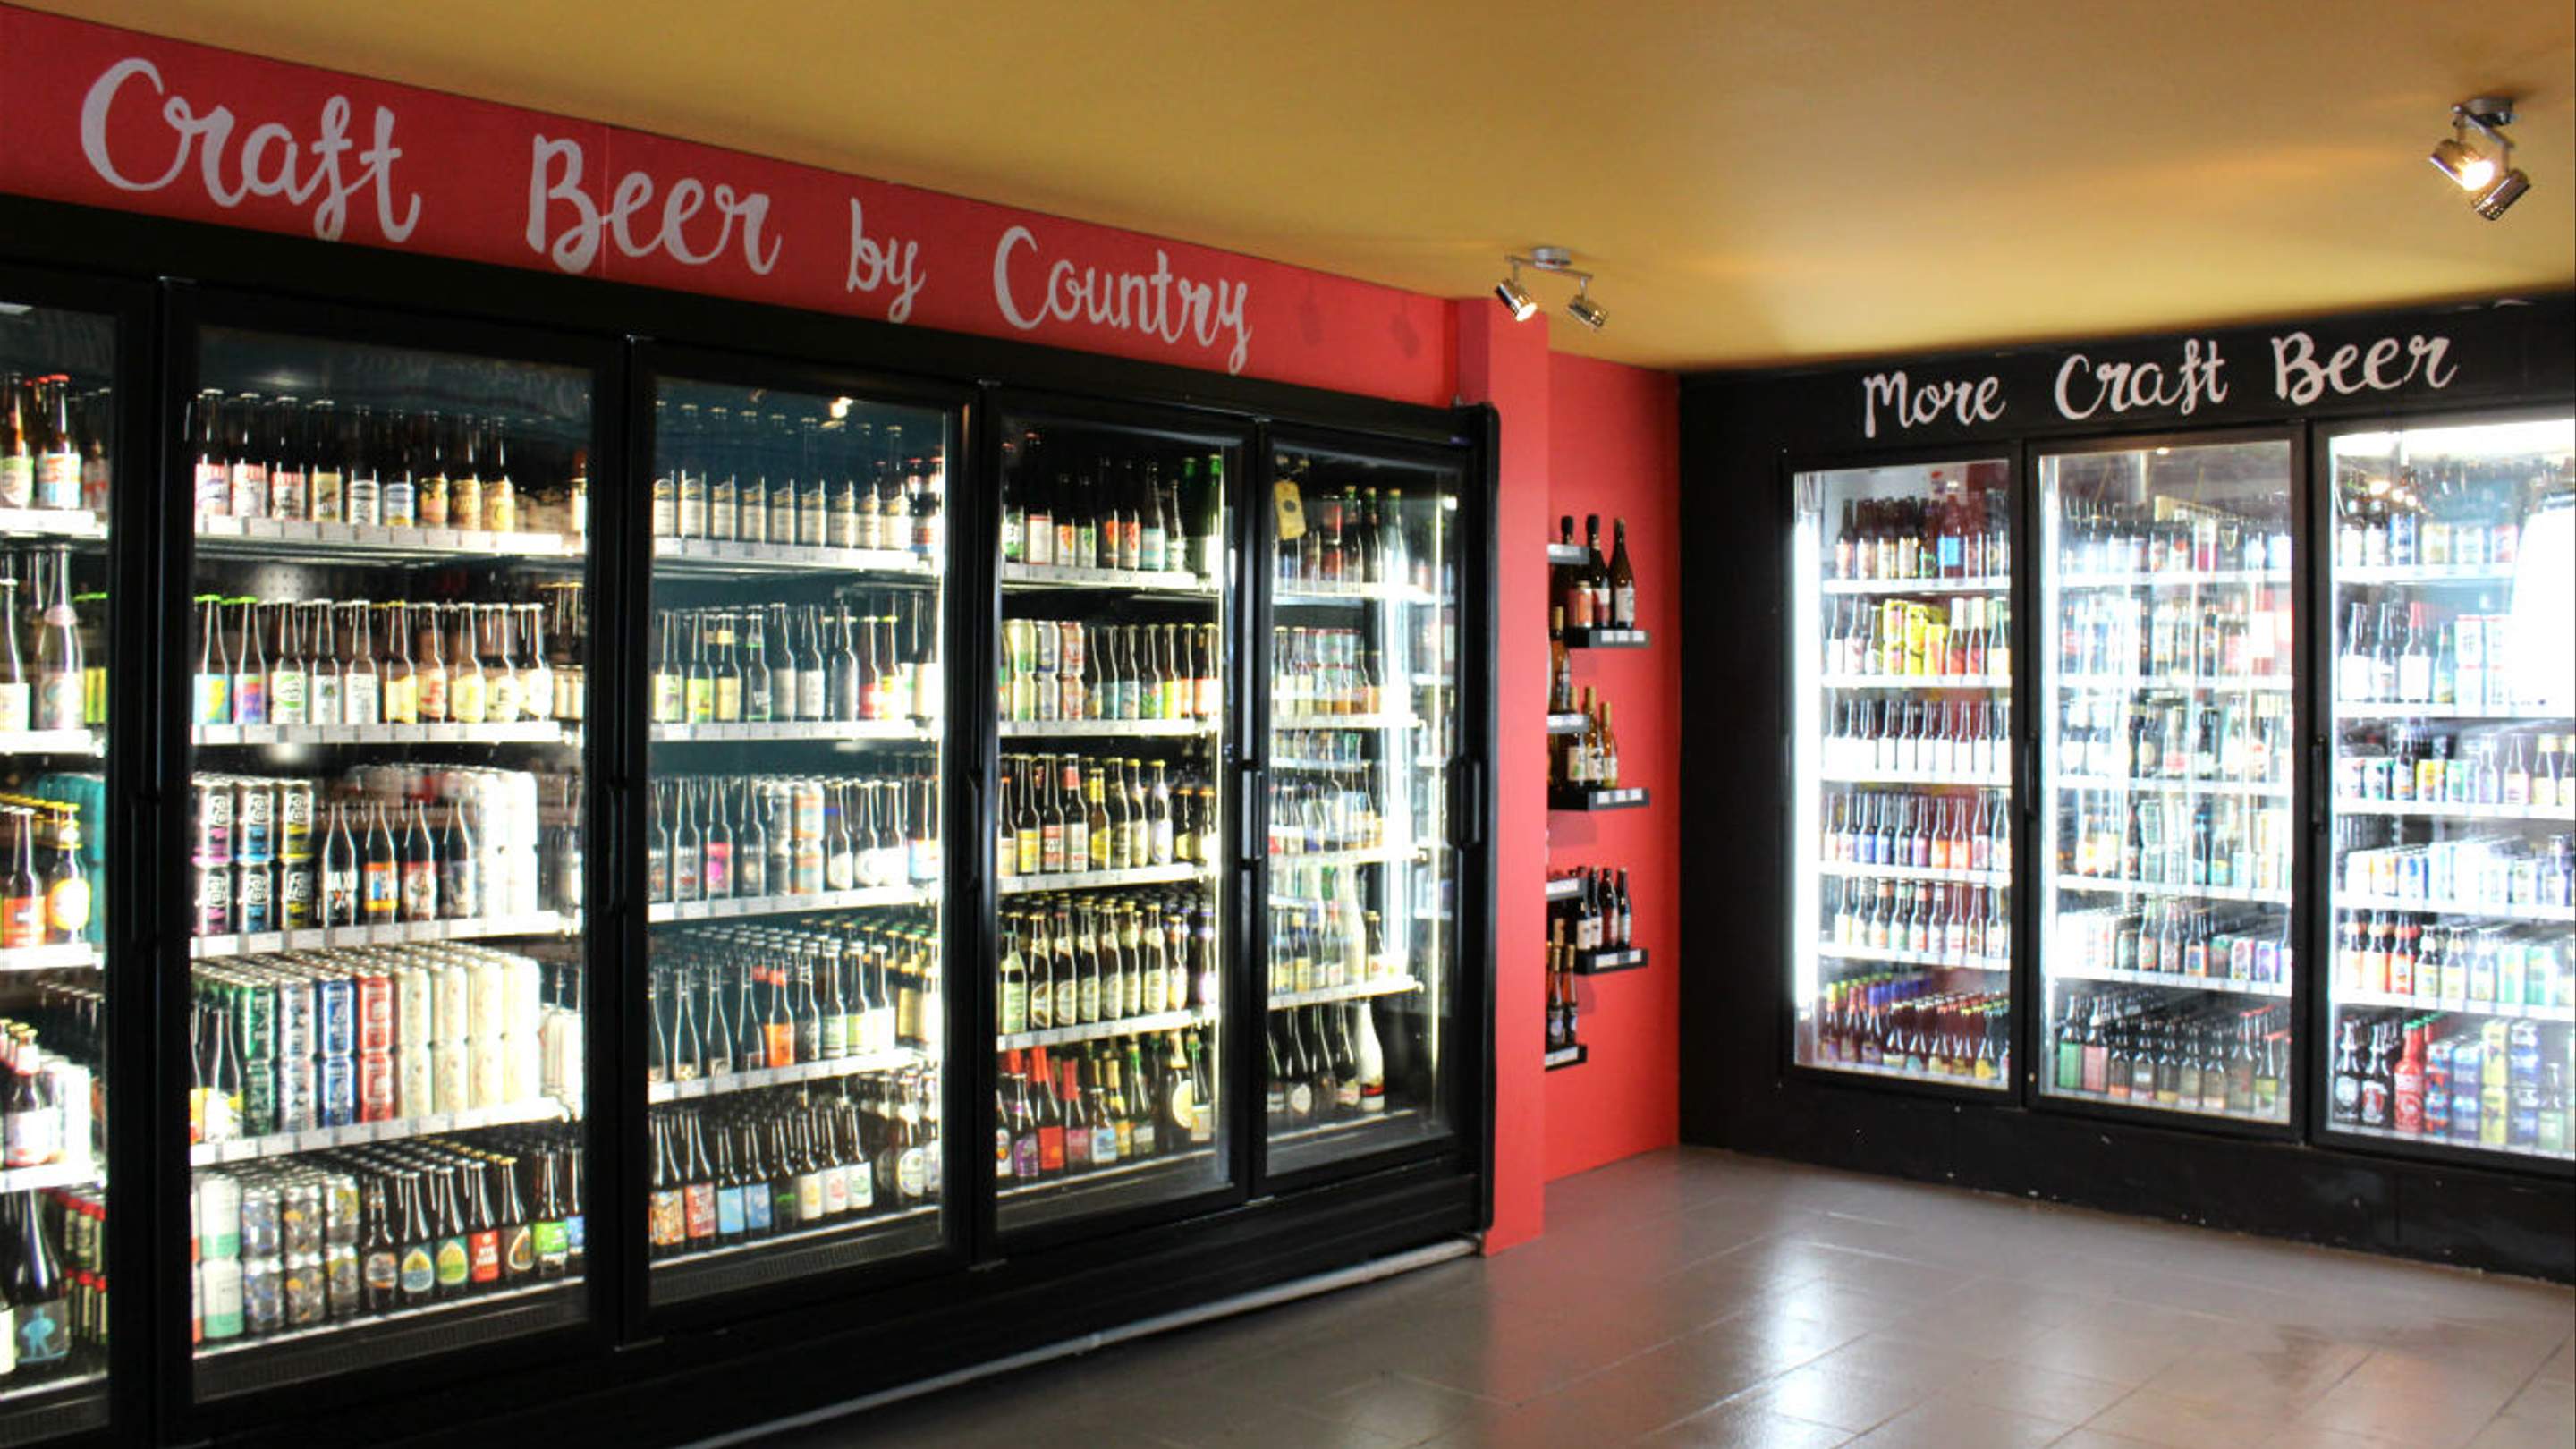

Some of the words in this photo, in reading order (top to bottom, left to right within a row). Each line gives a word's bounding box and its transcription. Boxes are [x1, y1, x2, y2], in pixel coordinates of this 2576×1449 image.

[80, 57, 421, 243] Craft
[526, 134, 783, 275] Beer
[847, 198, 926, 323] by
[993, 225, 1250, 376] Country
[1863, 371, 2006, 438] More
[2055, 337, 2229, 420] Craft
[2270, 331, 2458, 406] Beer
